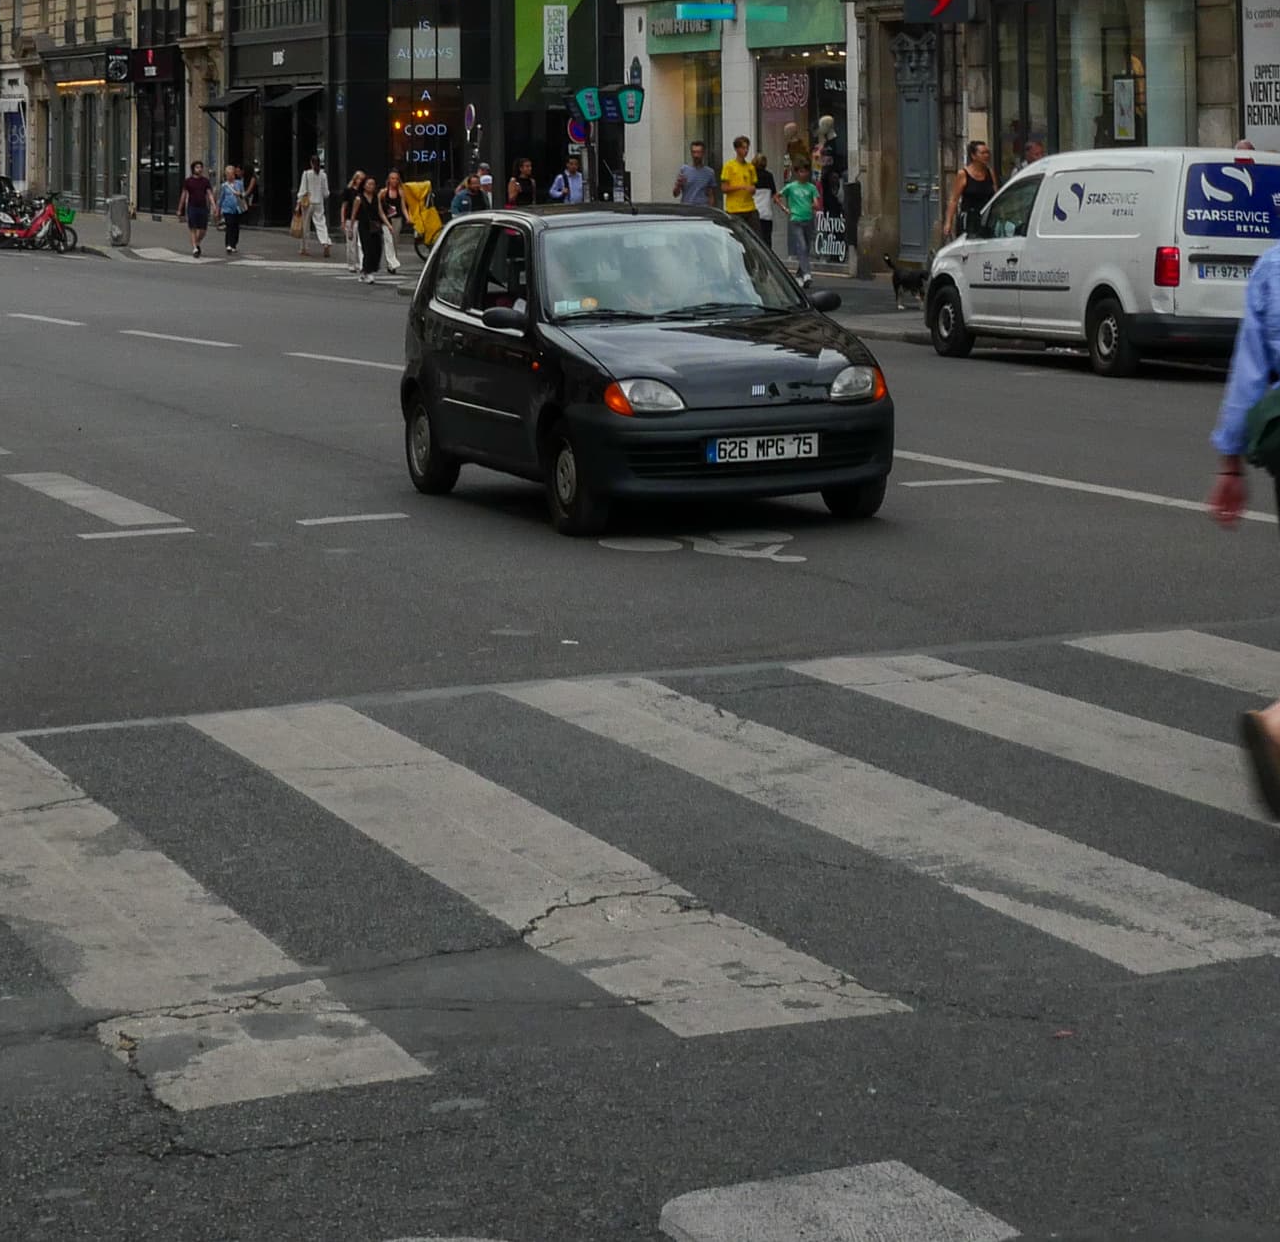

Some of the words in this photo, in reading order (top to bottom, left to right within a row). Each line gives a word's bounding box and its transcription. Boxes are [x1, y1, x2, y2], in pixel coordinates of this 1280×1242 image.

[419, 21, 431, 31] IS
[397, 48, 455, 59] ALWAYS
[1250, 81, 1274, 103] VIENT
[816, 210, 847, 234] Tokyo's
[1186, 209, 1271, 224] STARSERVICE
[1236, 224, 1271, 234] RETAIL
[815, 232, 846, 262] Calling
[718, 441, 748, 459] 626
[756, 438, 785, 458] MPG
[793, 436, 812, 455] 75
